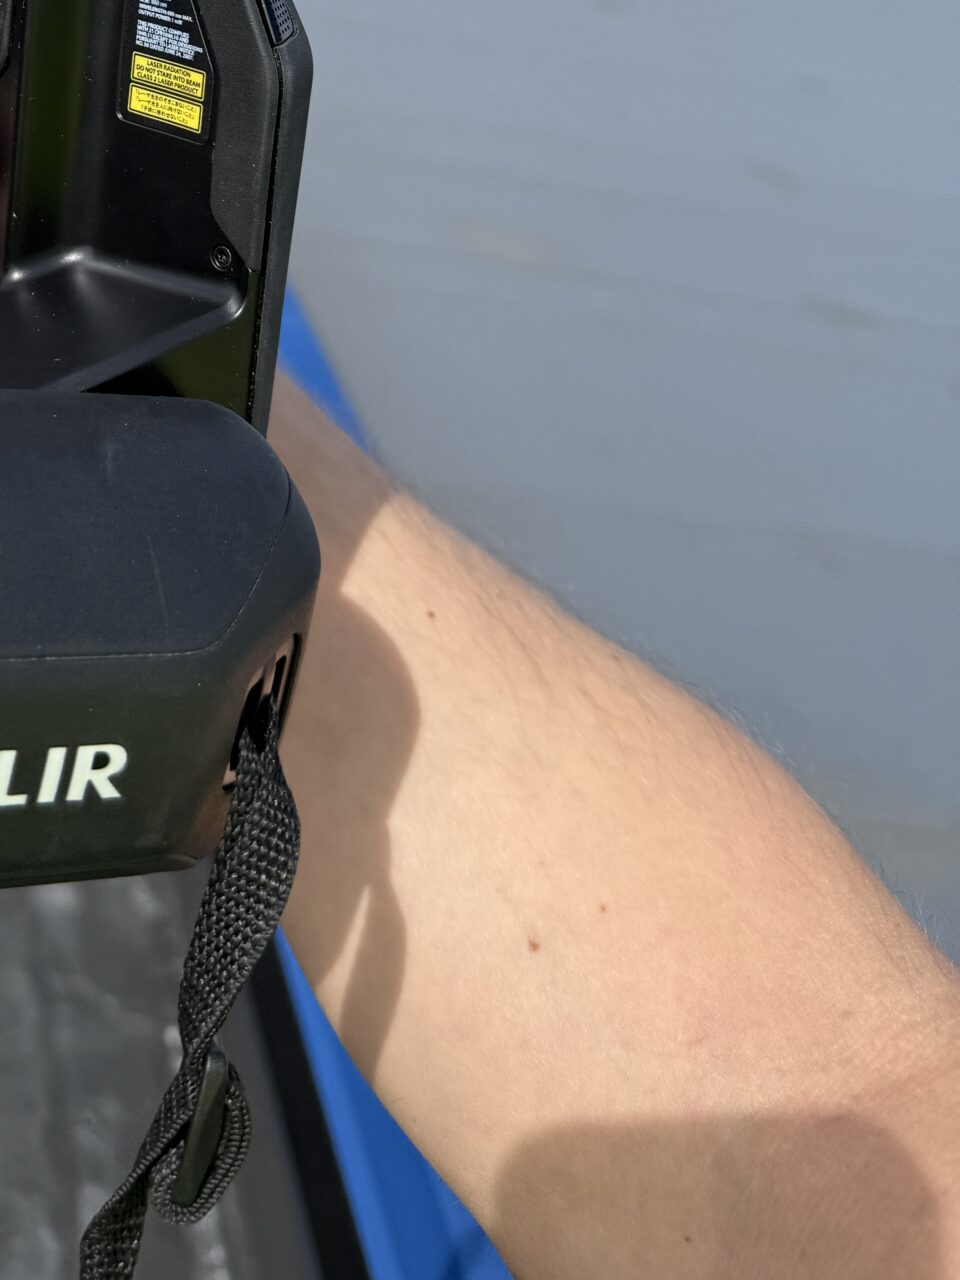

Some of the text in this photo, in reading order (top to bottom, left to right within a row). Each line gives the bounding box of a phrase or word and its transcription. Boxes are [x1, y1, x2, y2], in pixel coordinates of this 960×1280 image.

[145, 67, 156, 75] NOT
[157, 70, 172, 80] STARE
[173, 75, 185, 83] INTO
[186, 79, 201, 88] BEAM
[147, 60, 191, 78] LASER RADIATION
[137, 72, 153, 81] CLASS
[158, 78, 174, 87] LASER
[175, 83, 198, 95] PRODUCT
